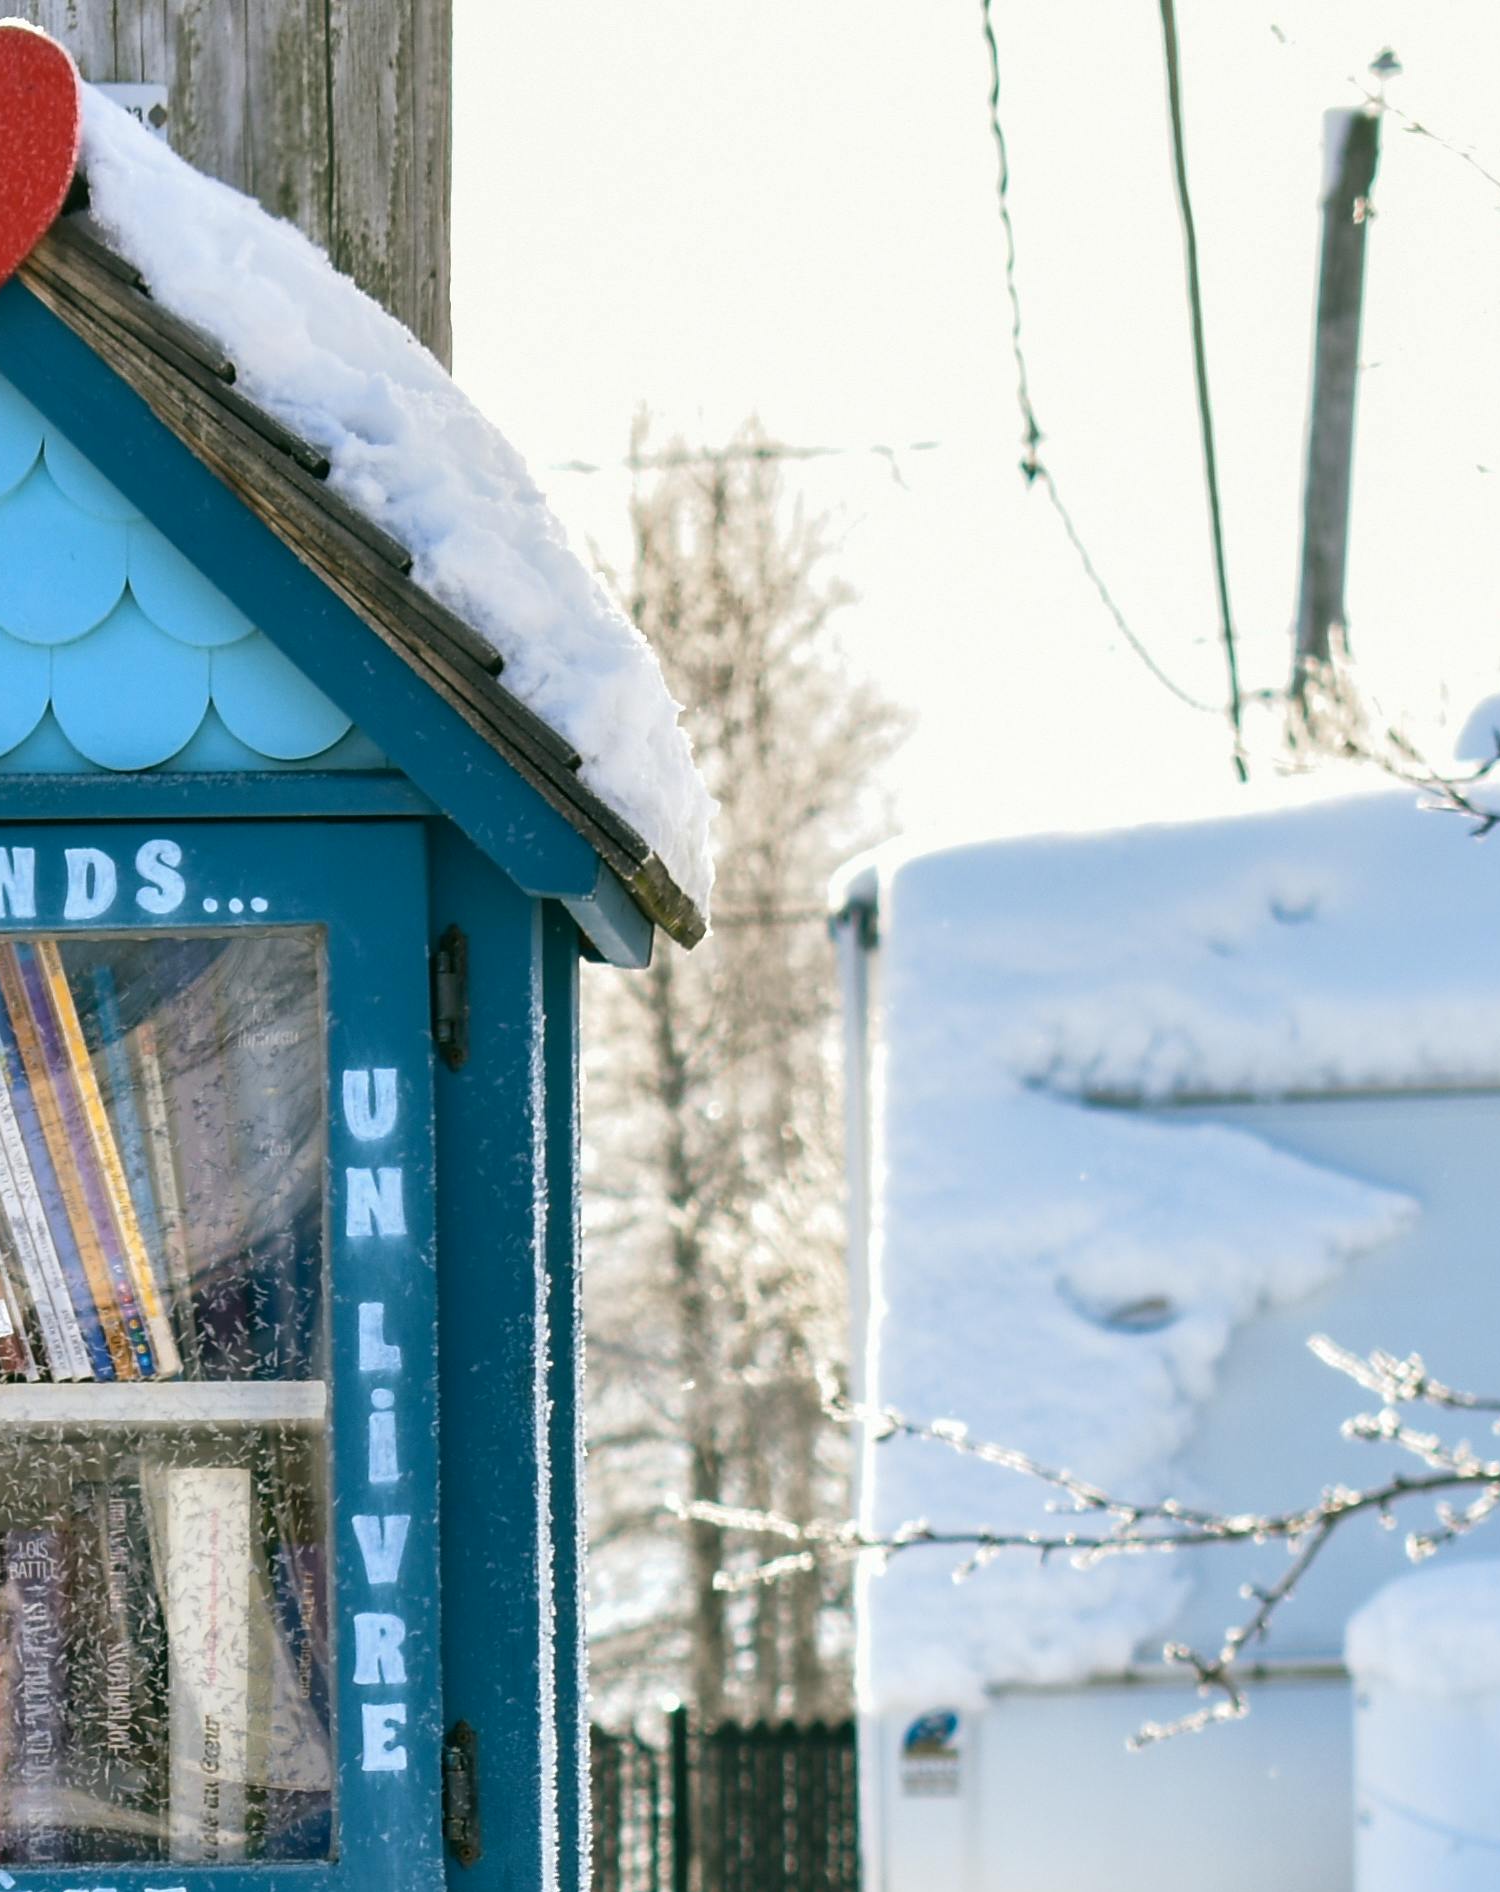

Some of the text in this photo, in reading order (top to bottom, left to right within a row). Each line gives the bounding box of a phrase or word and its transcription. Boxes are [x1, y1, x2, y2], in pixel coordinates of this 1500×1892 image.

[343, 1069, 406, 1237] UN
[18, 1540, 48, 1559] LOIS
[8, 1560, 59, 1580] BATTLE
